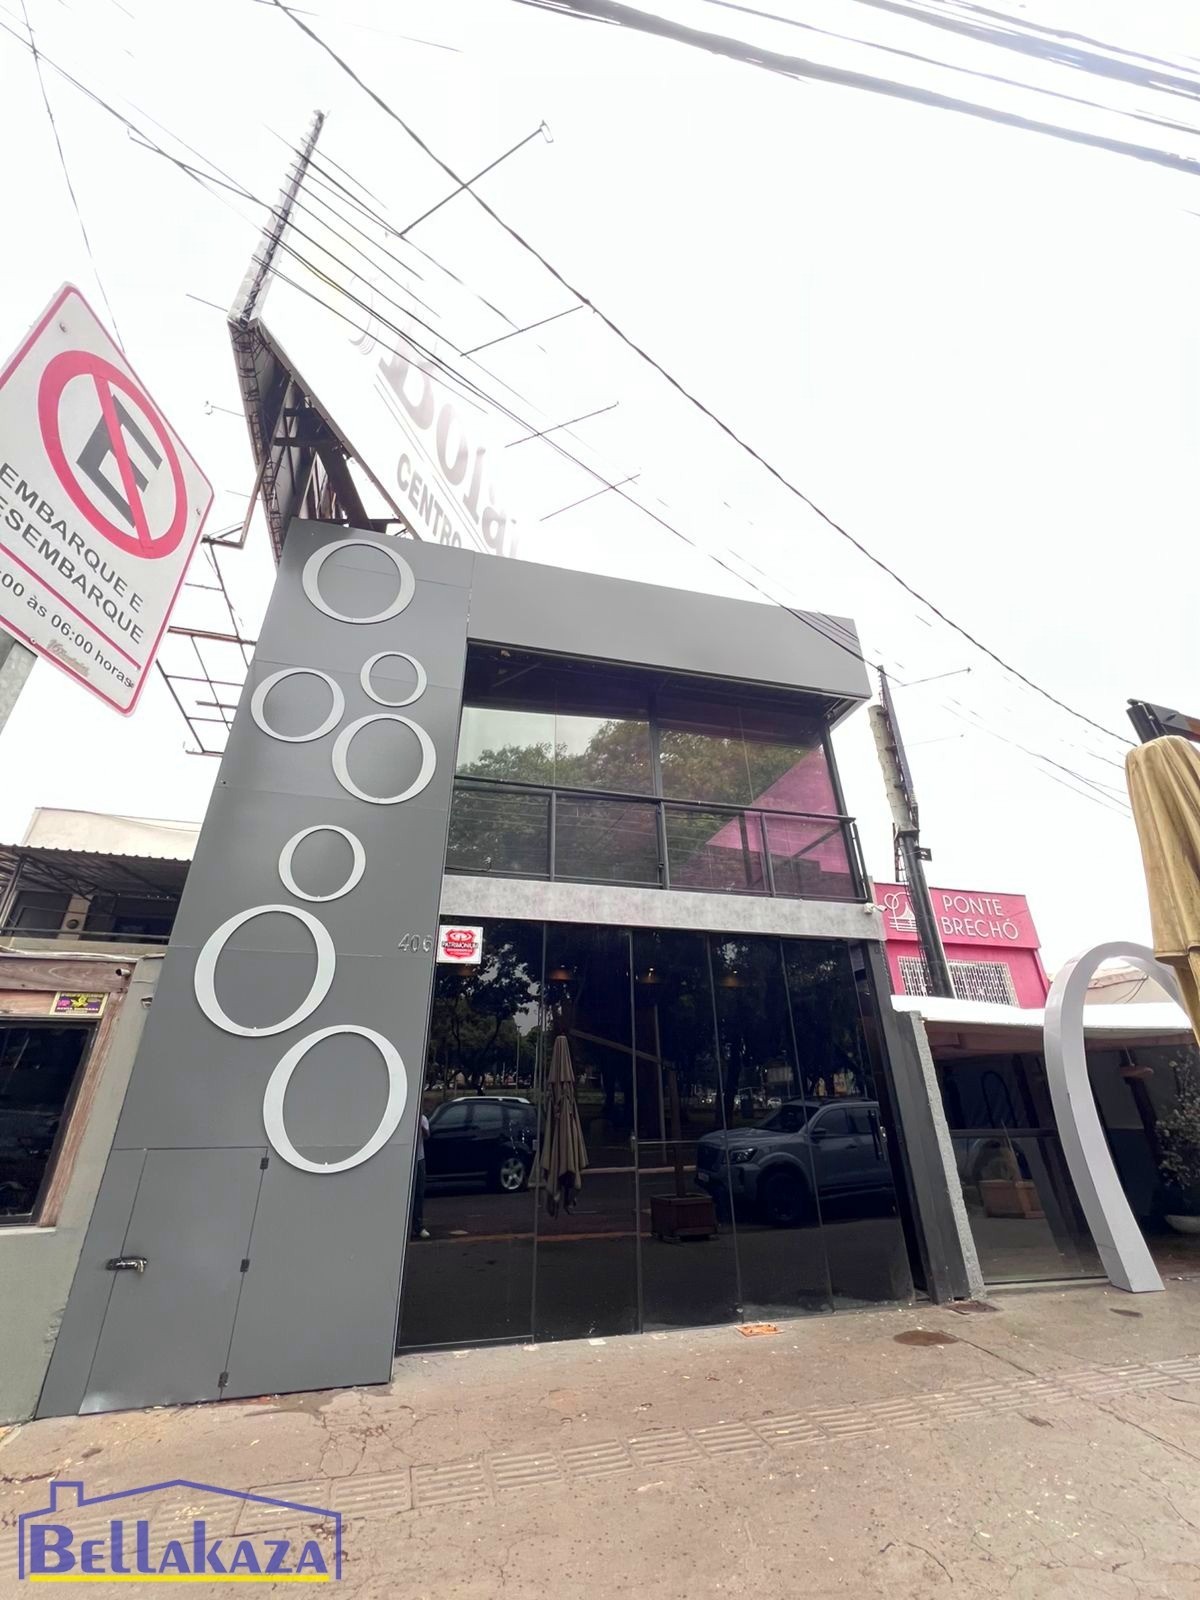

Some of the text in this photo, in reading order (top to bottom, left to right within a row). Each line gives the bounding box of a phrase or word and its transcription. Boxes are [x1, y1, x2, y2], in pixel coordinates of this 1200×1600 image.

[0, 462, 128, 598] EMBARQUE
[129, 593, 143, 613] E
[27, 595, 47, 618] às
[51, 614, 93, 654] 06:00
[95, 650, 134, 688] horas
[942, 895, 1004, 917] PONTE
[941, 917, 1019, 940] BRECHÓ
[398, 932, 432, 953] 406
